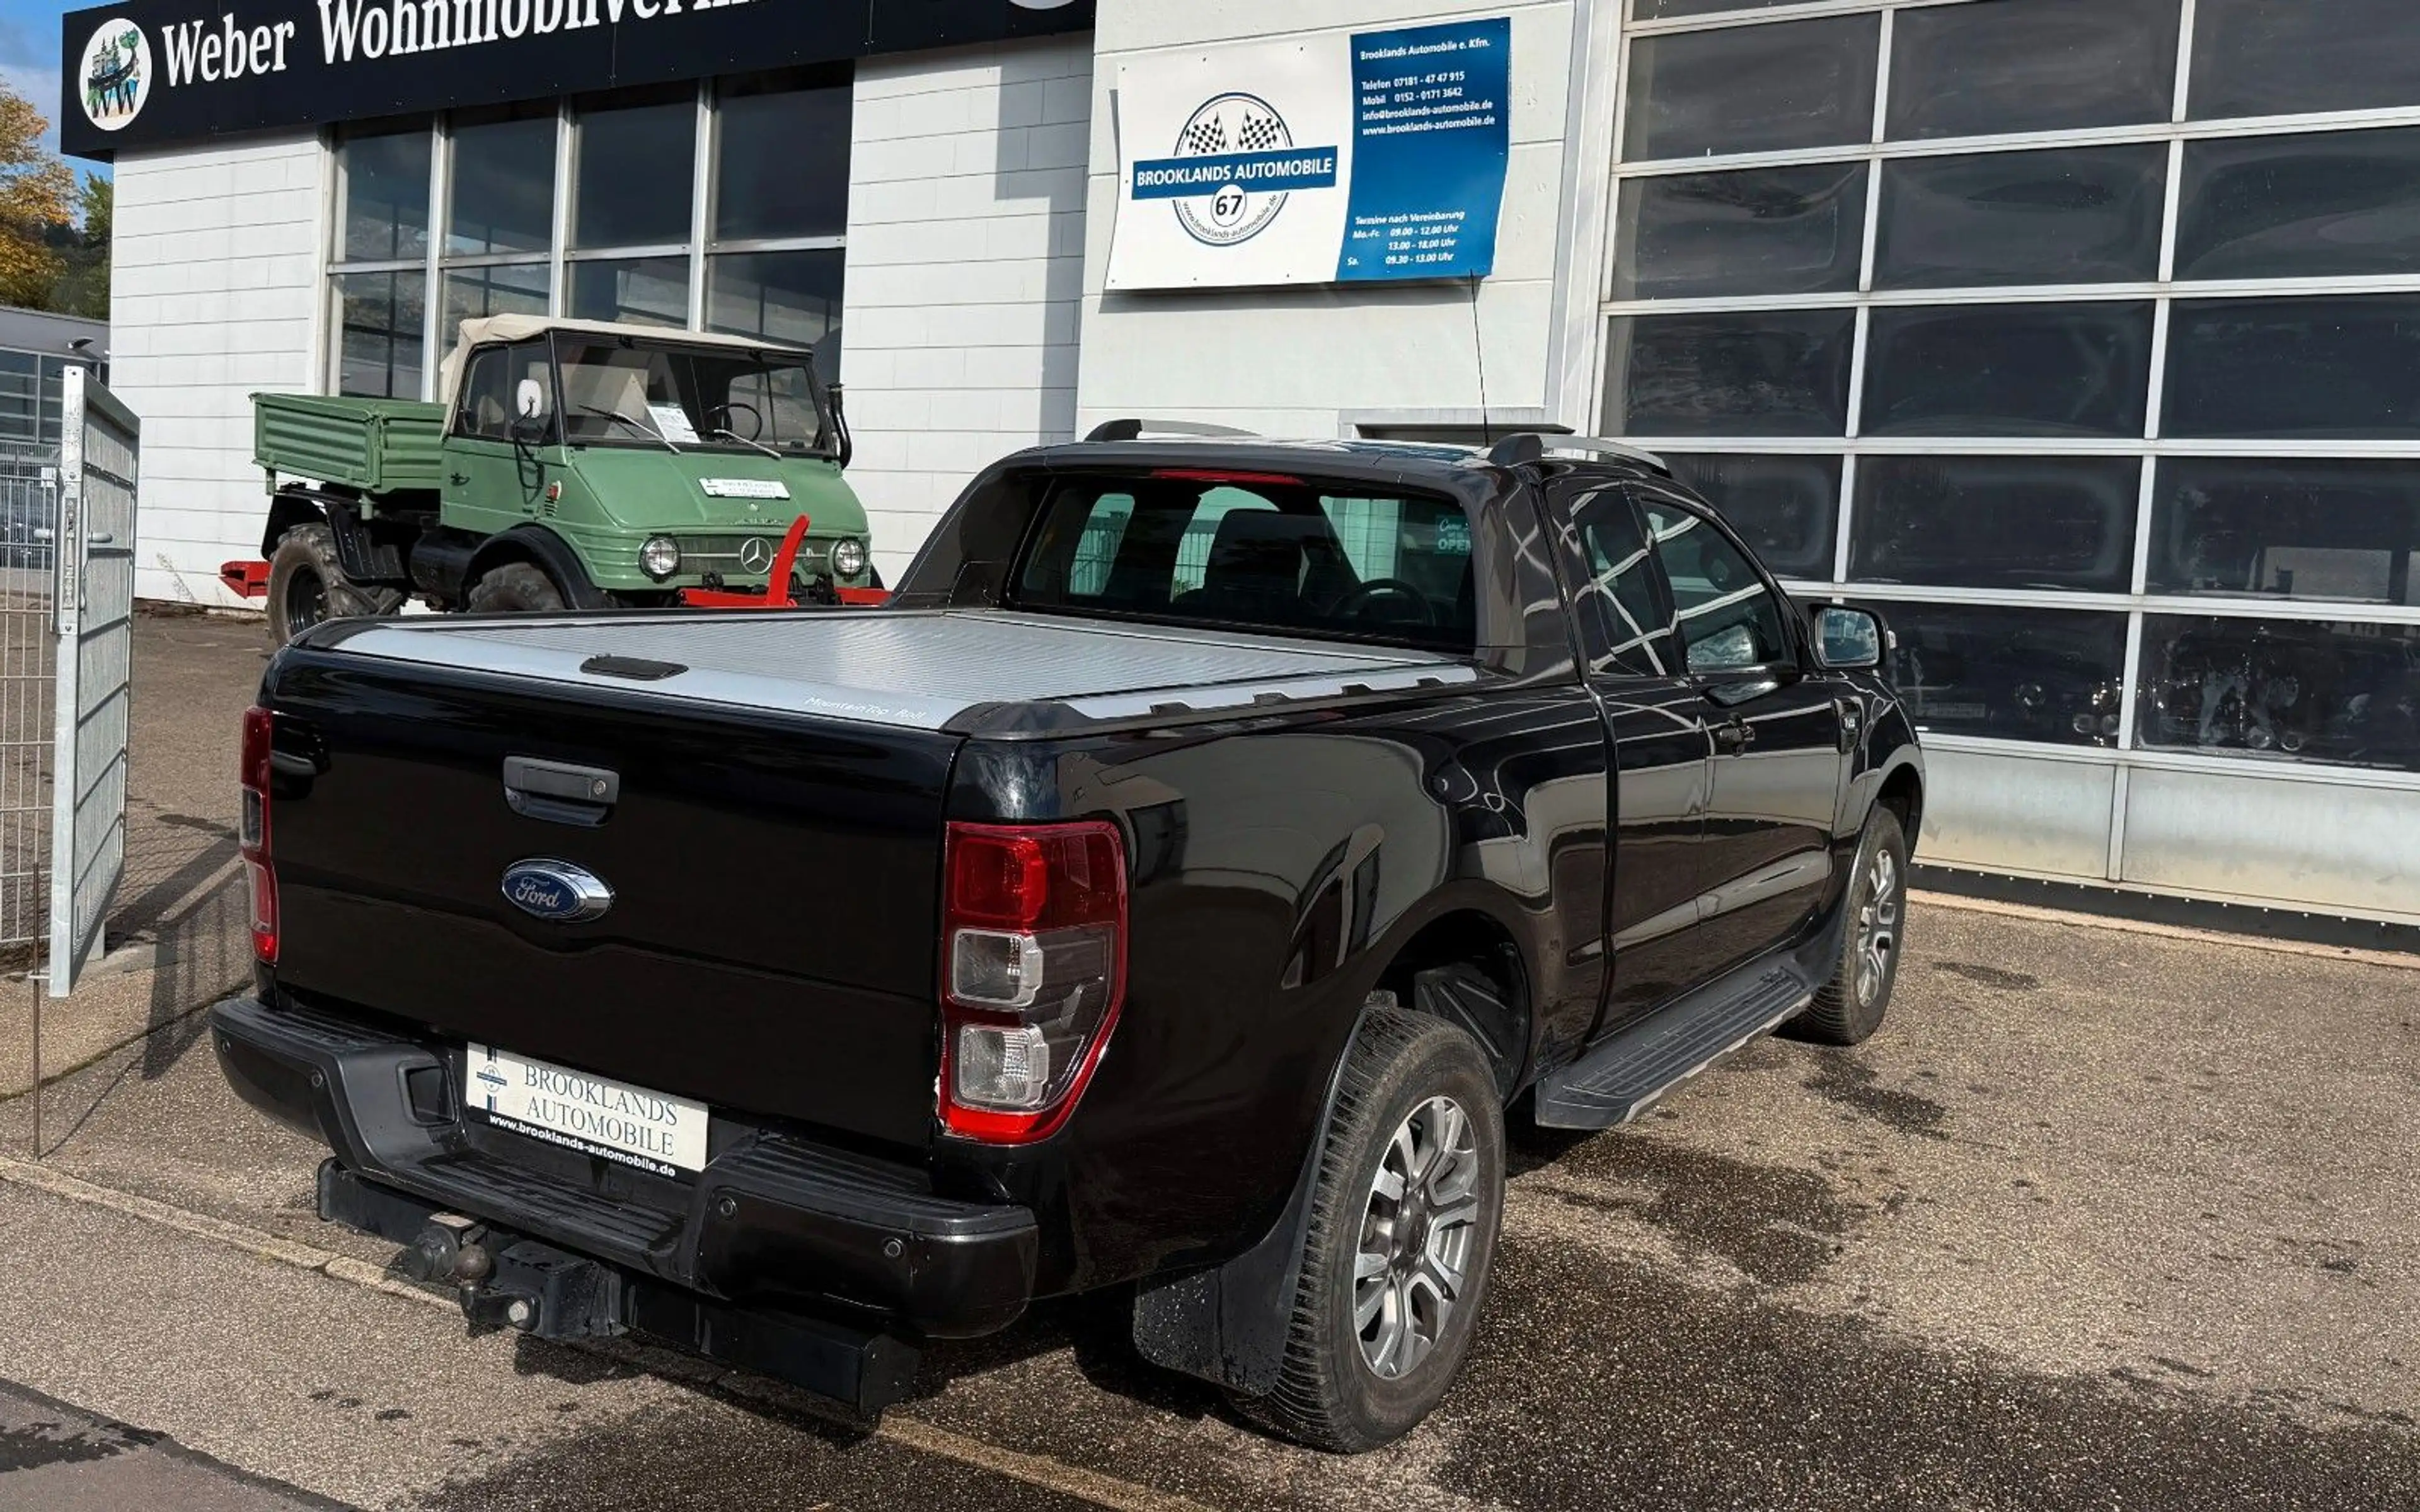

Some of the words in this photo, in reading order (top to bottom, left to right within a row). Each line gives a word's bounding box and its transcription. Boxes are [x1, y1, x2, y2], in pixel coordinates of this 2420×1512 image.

[163, 13, 294, 87] Weber
[320, 0, 750, 64] Wohnmob
[1361, 48, 1406, 60] Brooklands
[1408, 41, 1456, 55] Automobile
[1468, 38, 1490, 48] Kfm.
[1362, 80, 1391, 90] Telefon
[1393, 76, 1418, 87] 07181
[1425, 74, 1435, 84] 47
[1437, 72, 1447, 83] 47
[1449, 71, 1465, 81] 915
[1363, 95, 1386, 106] Mobil
[1395, 92, 1414, 102] 0152
[1420, 89, 1440, 100] 0171
[1363, 100, 1493, 121] info@brooklands-automobile.de
[1363, 115, 1495, 135] www.brooklands-automobile.de
[1137, 165, 1230, 186] BROOKLANDS
[1235, 158, 1332, 180] AUTOMOBILE
[1216, 195, 1243, 215] 67
[1356, 215, 1386, 224] Termine
[1388, 214, 1408, 223] nach
[1410, 210, 1465, 222] Vereinbarung
[1390, 227, 1412, 237] 09.00
[1420, 226, 1442, 235] 12.00
[1444, 224, 1458, 233] Uhr
[1441, 238, 1455, 248] Uhr
[1439, 252, 1453, 261] Uhr
[516, 876, 561, 908] Ford
[525, 1065, 677, 1125] BROOKLANDS
[527, 1096, 674, 1156] AUTOMOBILE
[490, 1114, 676, 1177] www.brooklands-automobile.de
